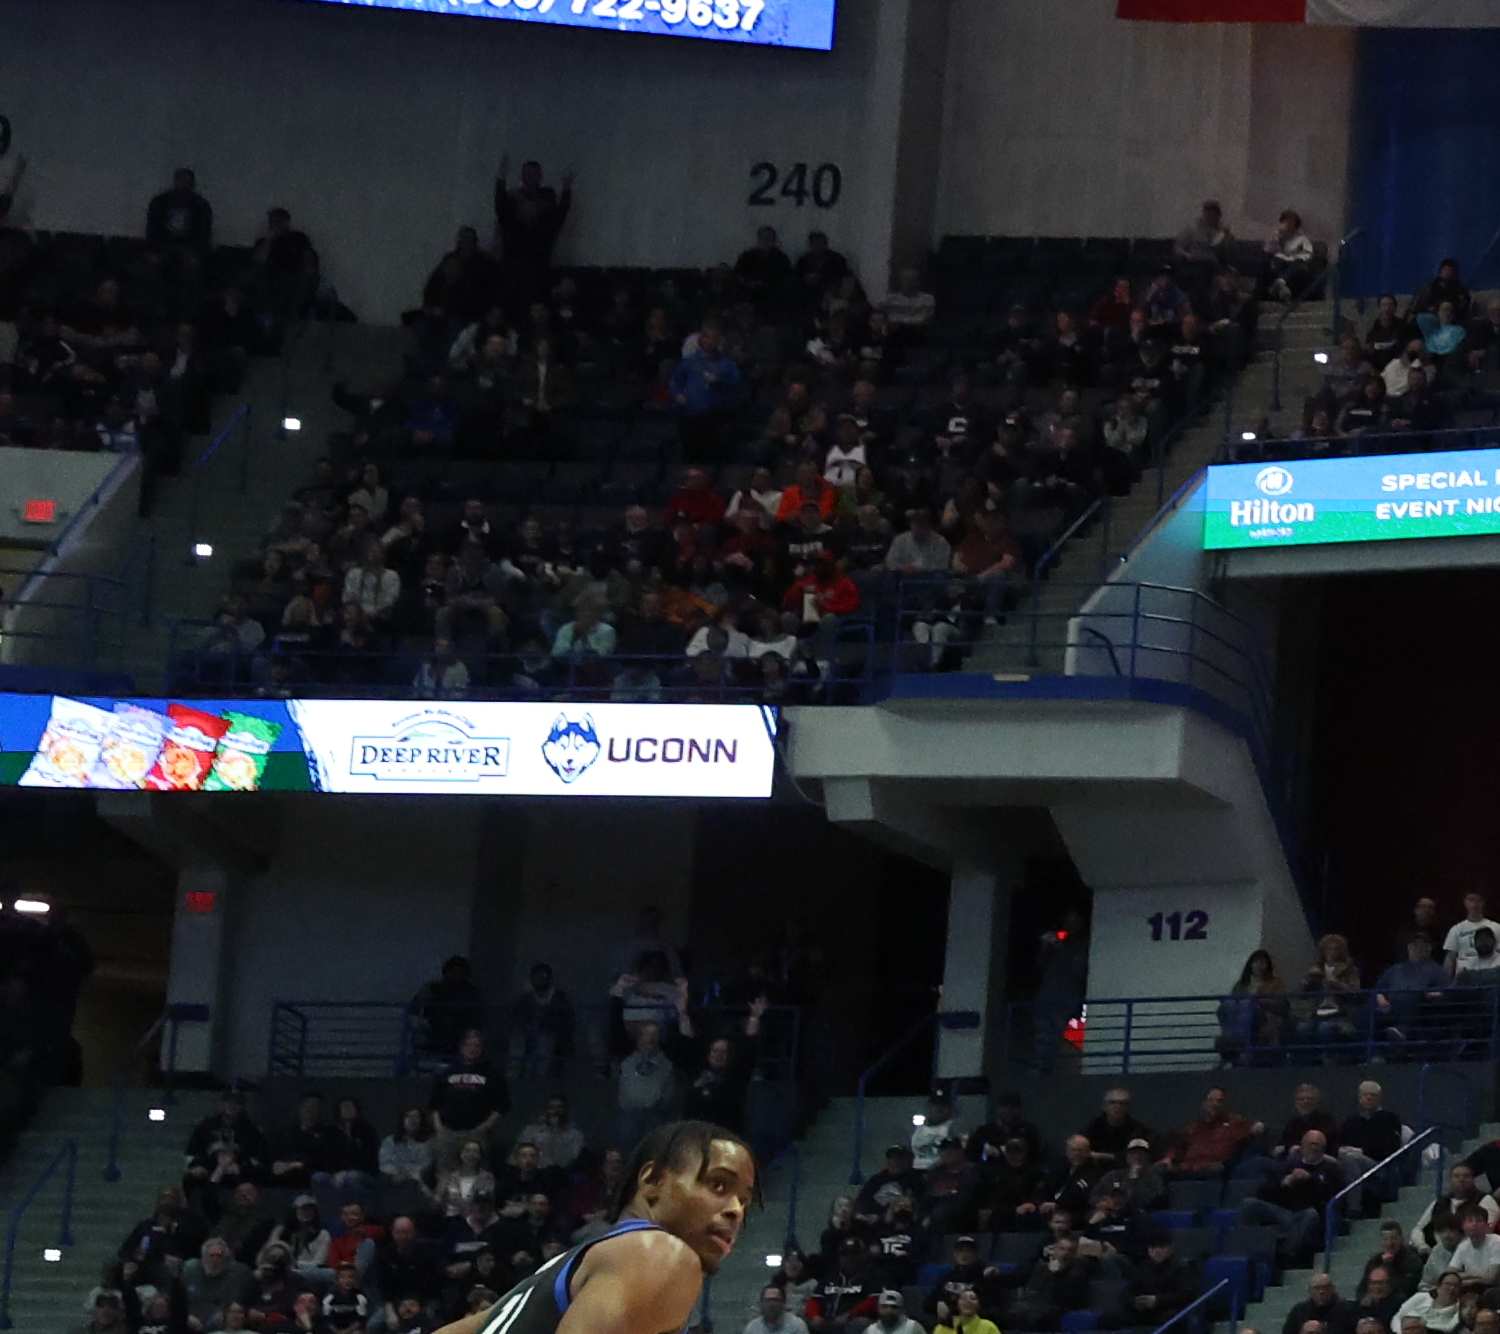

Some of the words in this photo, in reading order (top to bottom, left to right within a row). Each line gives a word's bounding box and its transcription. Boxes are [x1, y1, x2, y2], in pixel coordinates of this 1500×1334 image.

[749, 162, 842, 209] 240
[1381, 470, 1489, 492] SPECIAL
[1230, 500, 1315, 527] Hilton
[1376, 499, 1459, 521] EVENT
[361, 744, 421, 766] DEEP
[426, 746, 501, 767] RIVER
[607, 735, 738, 764] UCONN
[1147, 910, 1209, 941] 112
